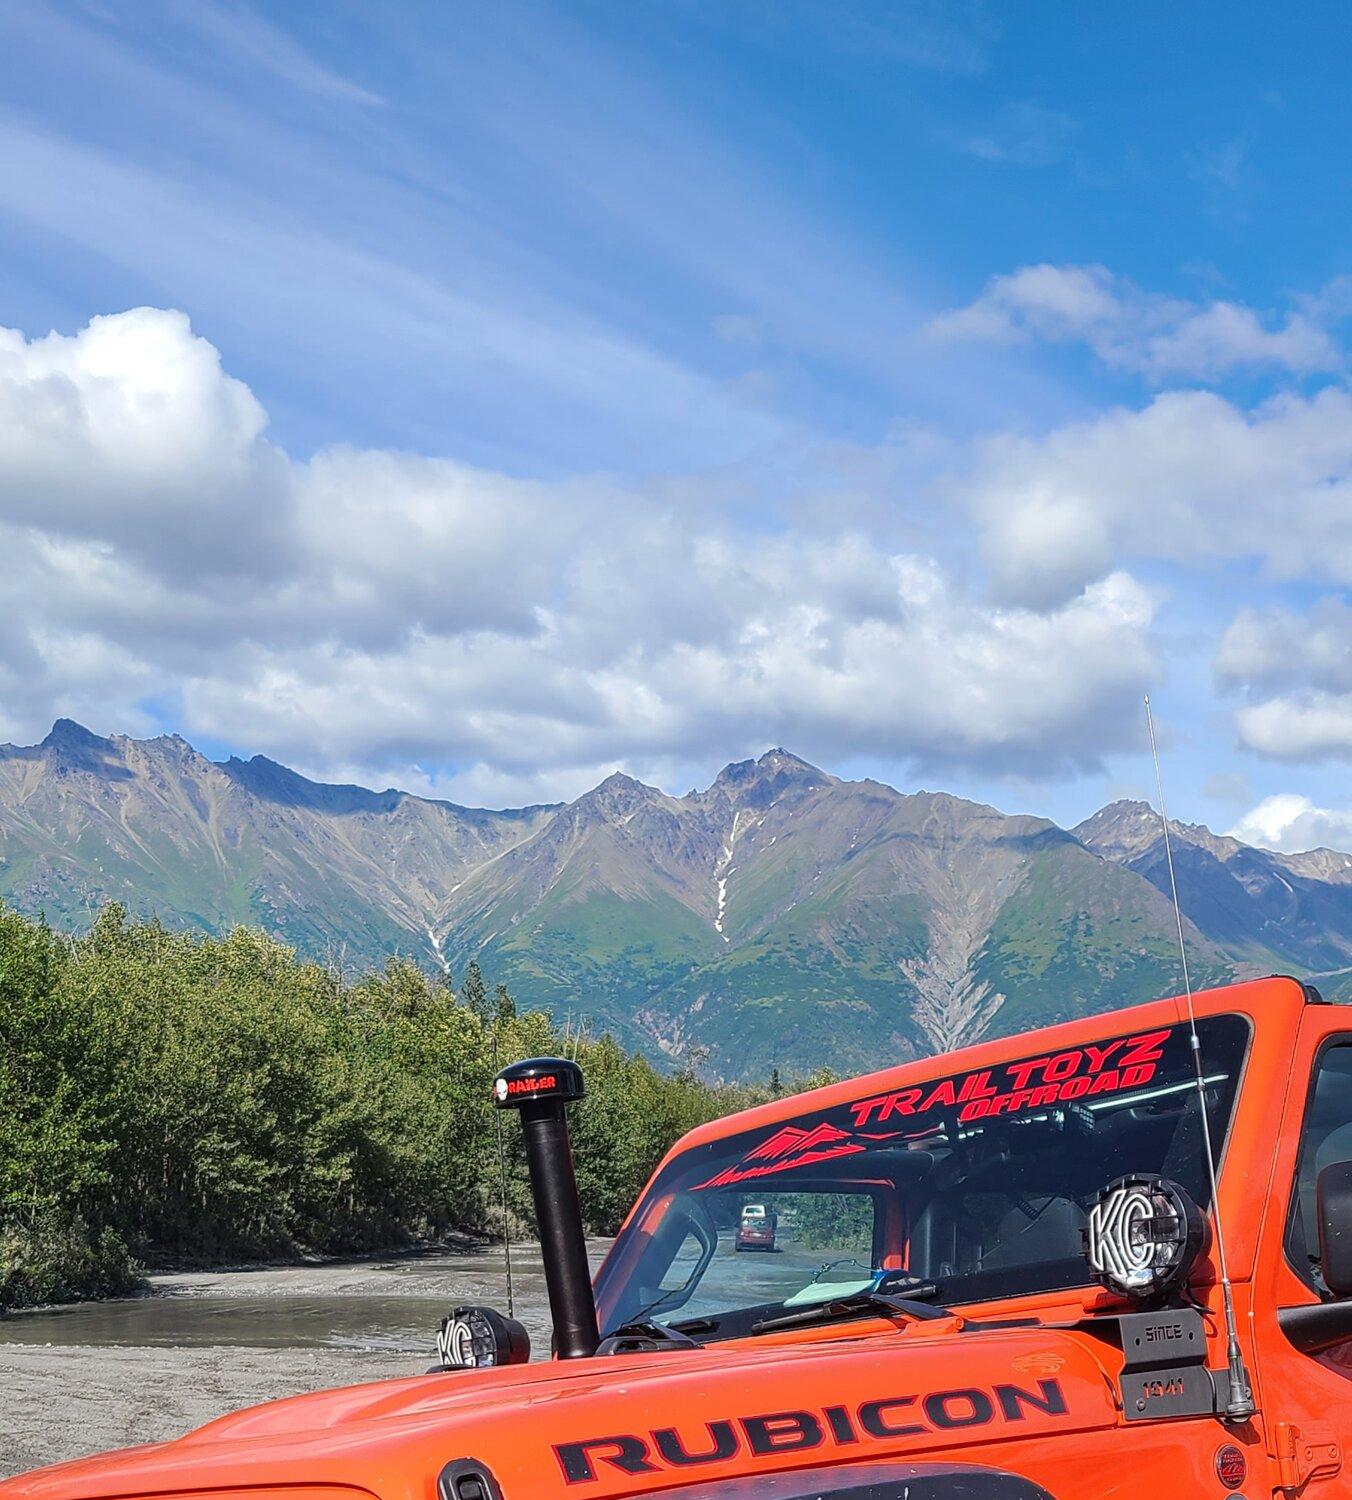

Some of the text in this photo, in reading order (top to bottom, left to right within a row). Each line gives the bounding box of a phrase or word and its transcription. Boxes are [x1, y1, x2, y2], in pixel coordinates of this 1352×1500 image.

[850, 1029, 1172, 1127] TRAIL TOYZ
[957, 1063, 1158, 1122] OFFROAD
[1090, 1189, 1155, 1278] KC
[437, 1319, 476, 1367] KC
[1143, 1378, 1184, 1399] 1941
[551, 1377, 1071, 1486] RUBICON
